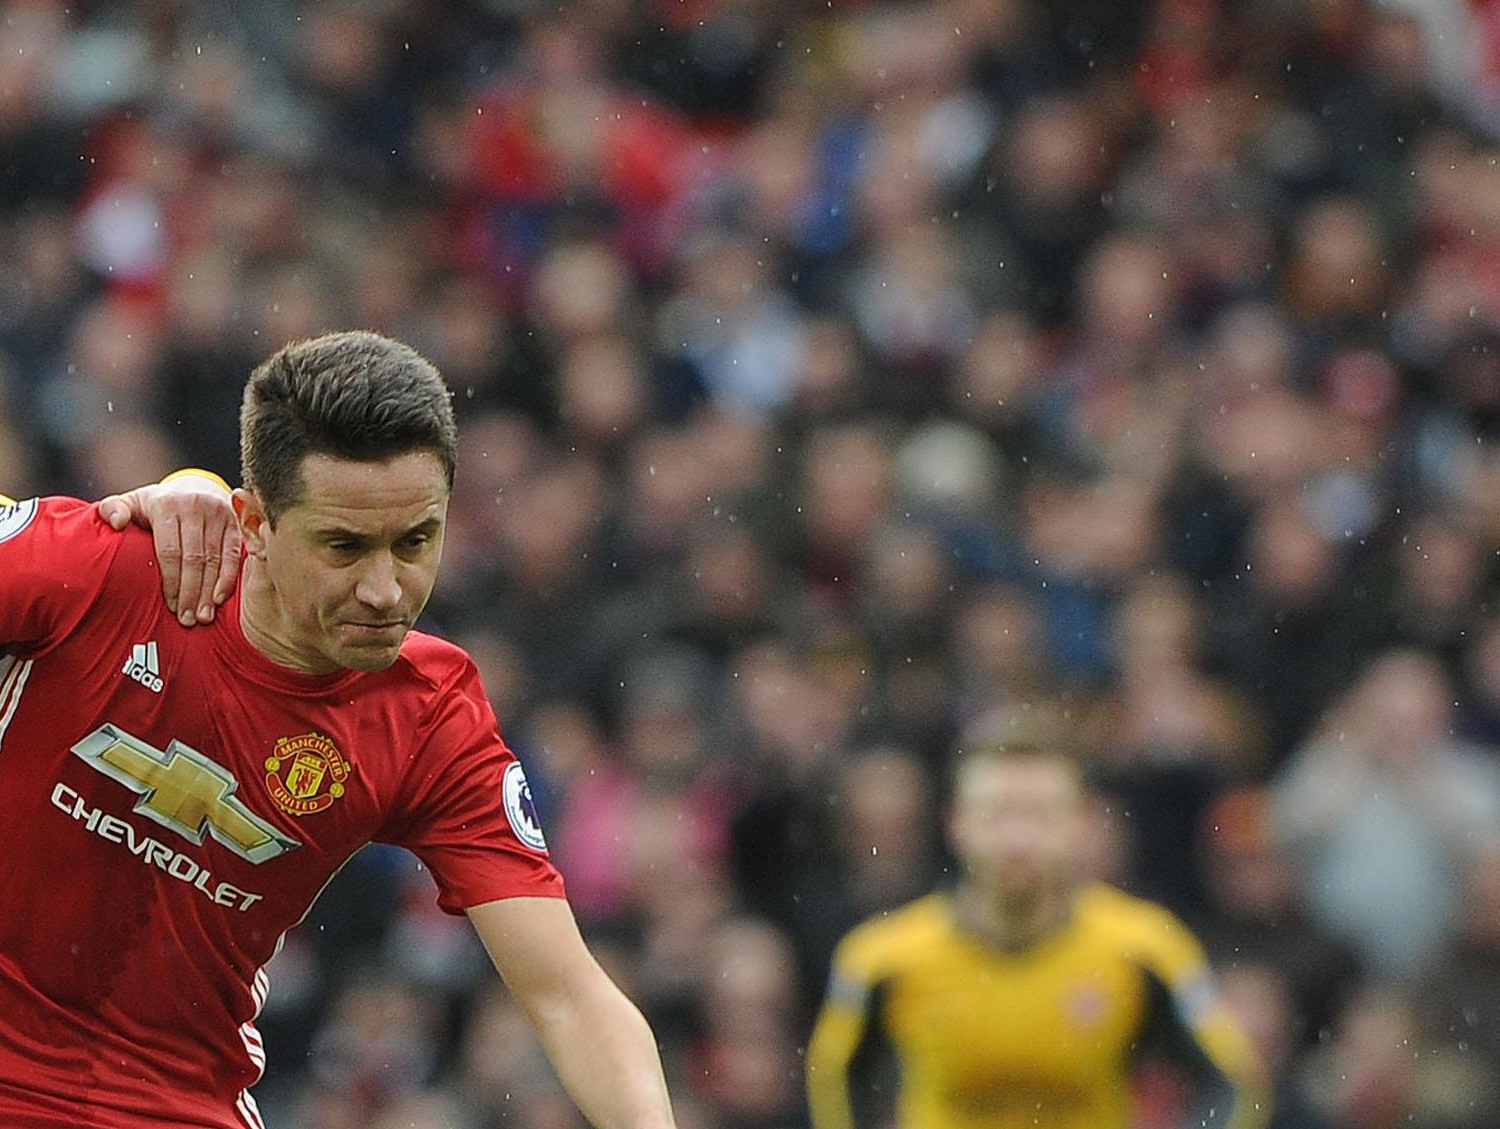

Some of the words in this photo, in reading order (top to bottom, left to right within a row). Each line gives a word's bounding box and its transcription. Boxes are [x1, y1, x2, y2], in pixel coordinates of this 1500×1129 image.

[280, 739, 343, 777] MANCHESTER
[274, 788, 318, 810] UNITED
[50, 782, 263, 912] CHEVROLET
